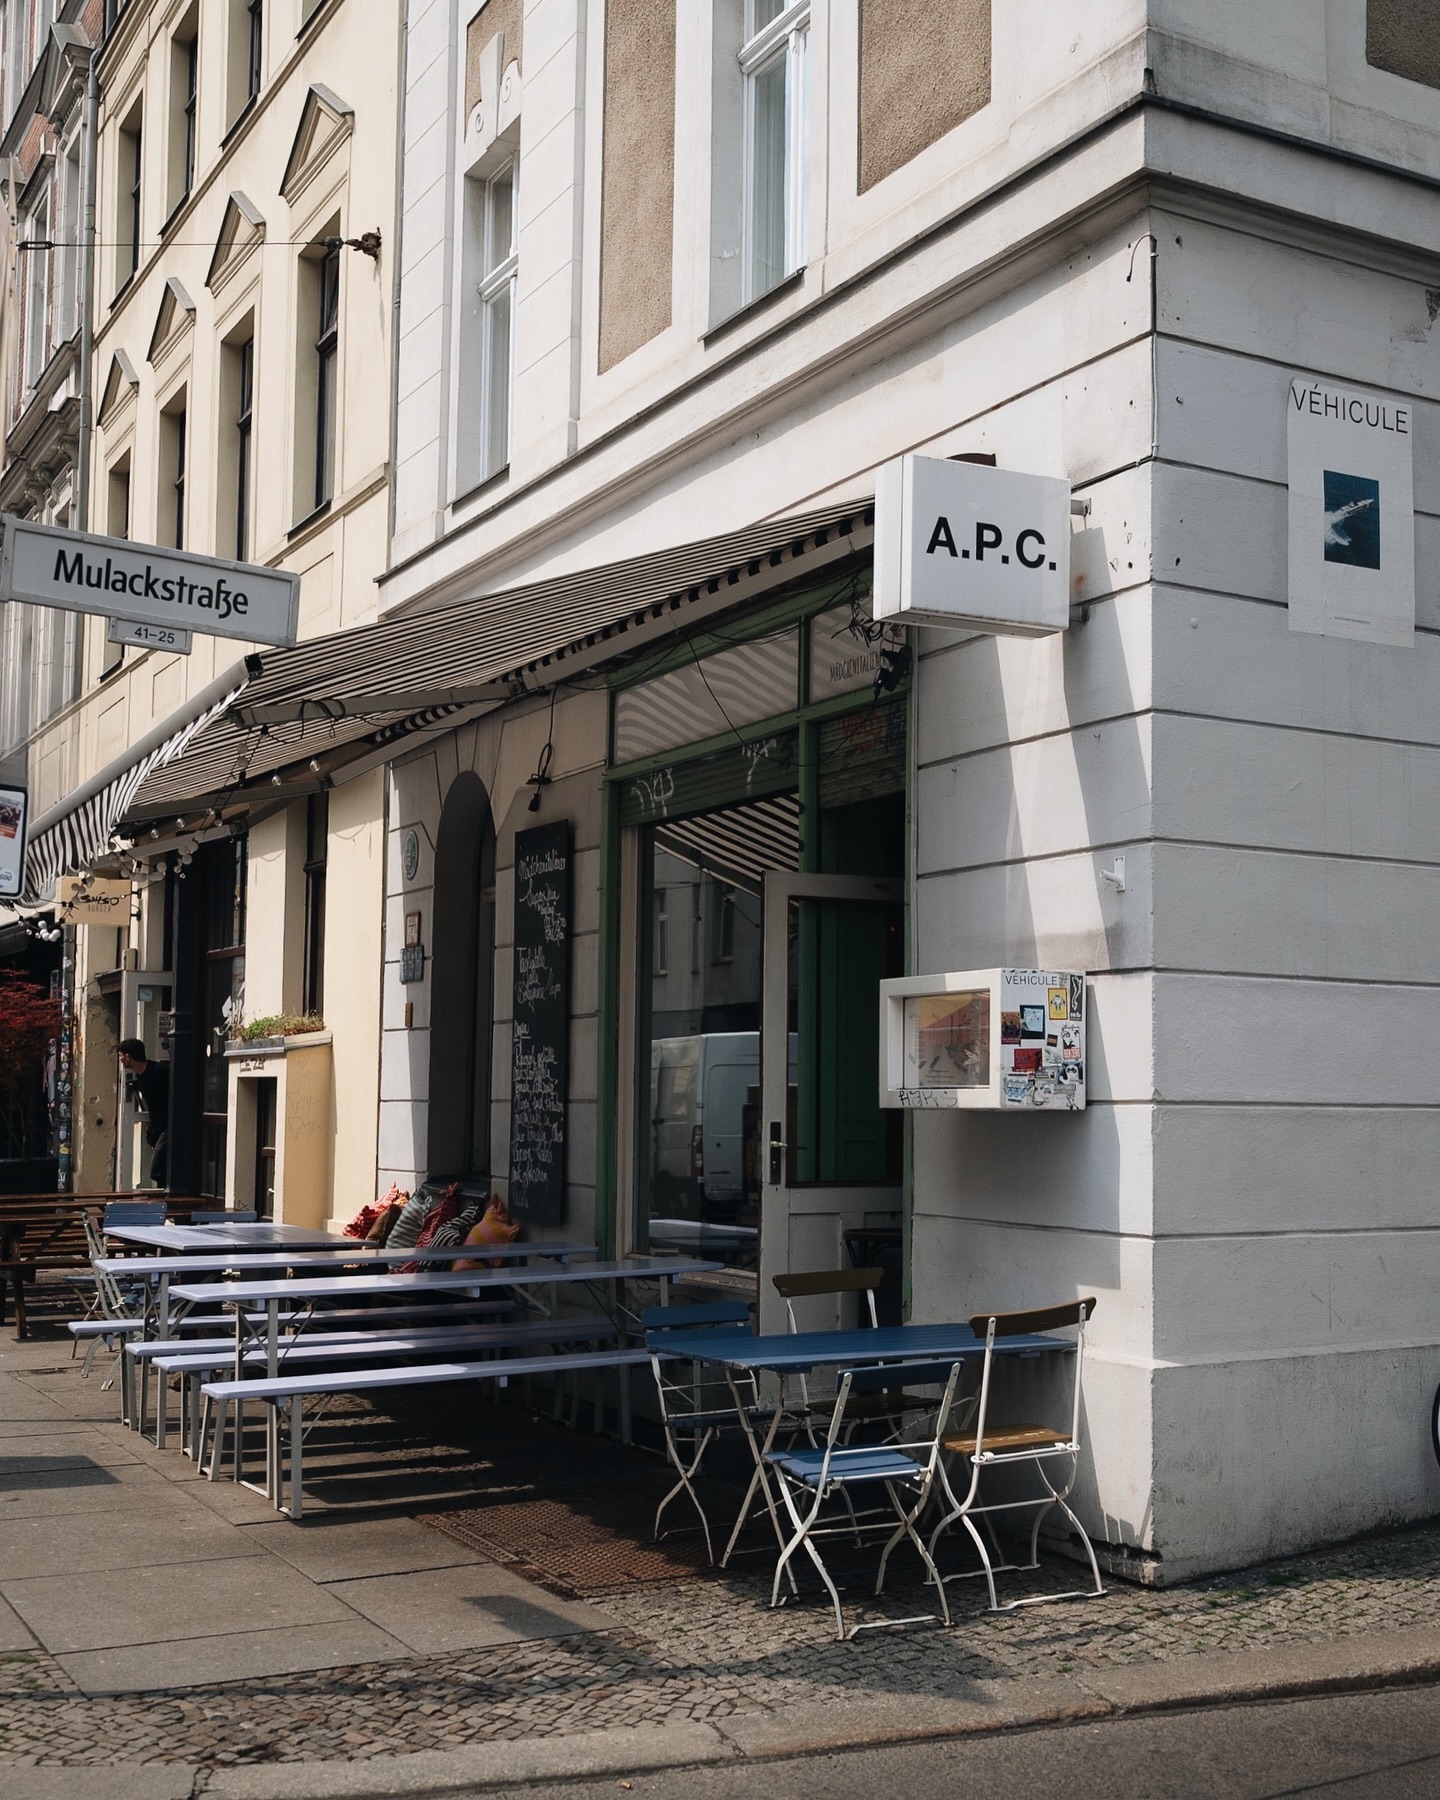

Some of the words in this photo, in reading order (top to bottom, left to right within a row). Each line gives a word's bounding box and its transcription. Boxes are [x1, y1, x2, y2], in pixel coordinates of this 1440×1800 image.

[1291, 383, 1408, 435] VÉHICULE
[926, 516, 1057, 571] A.P.C.
[53, 549, 249, 619] Mulackstraße
[1005, 972, 1058, 986] VÉHICULE
